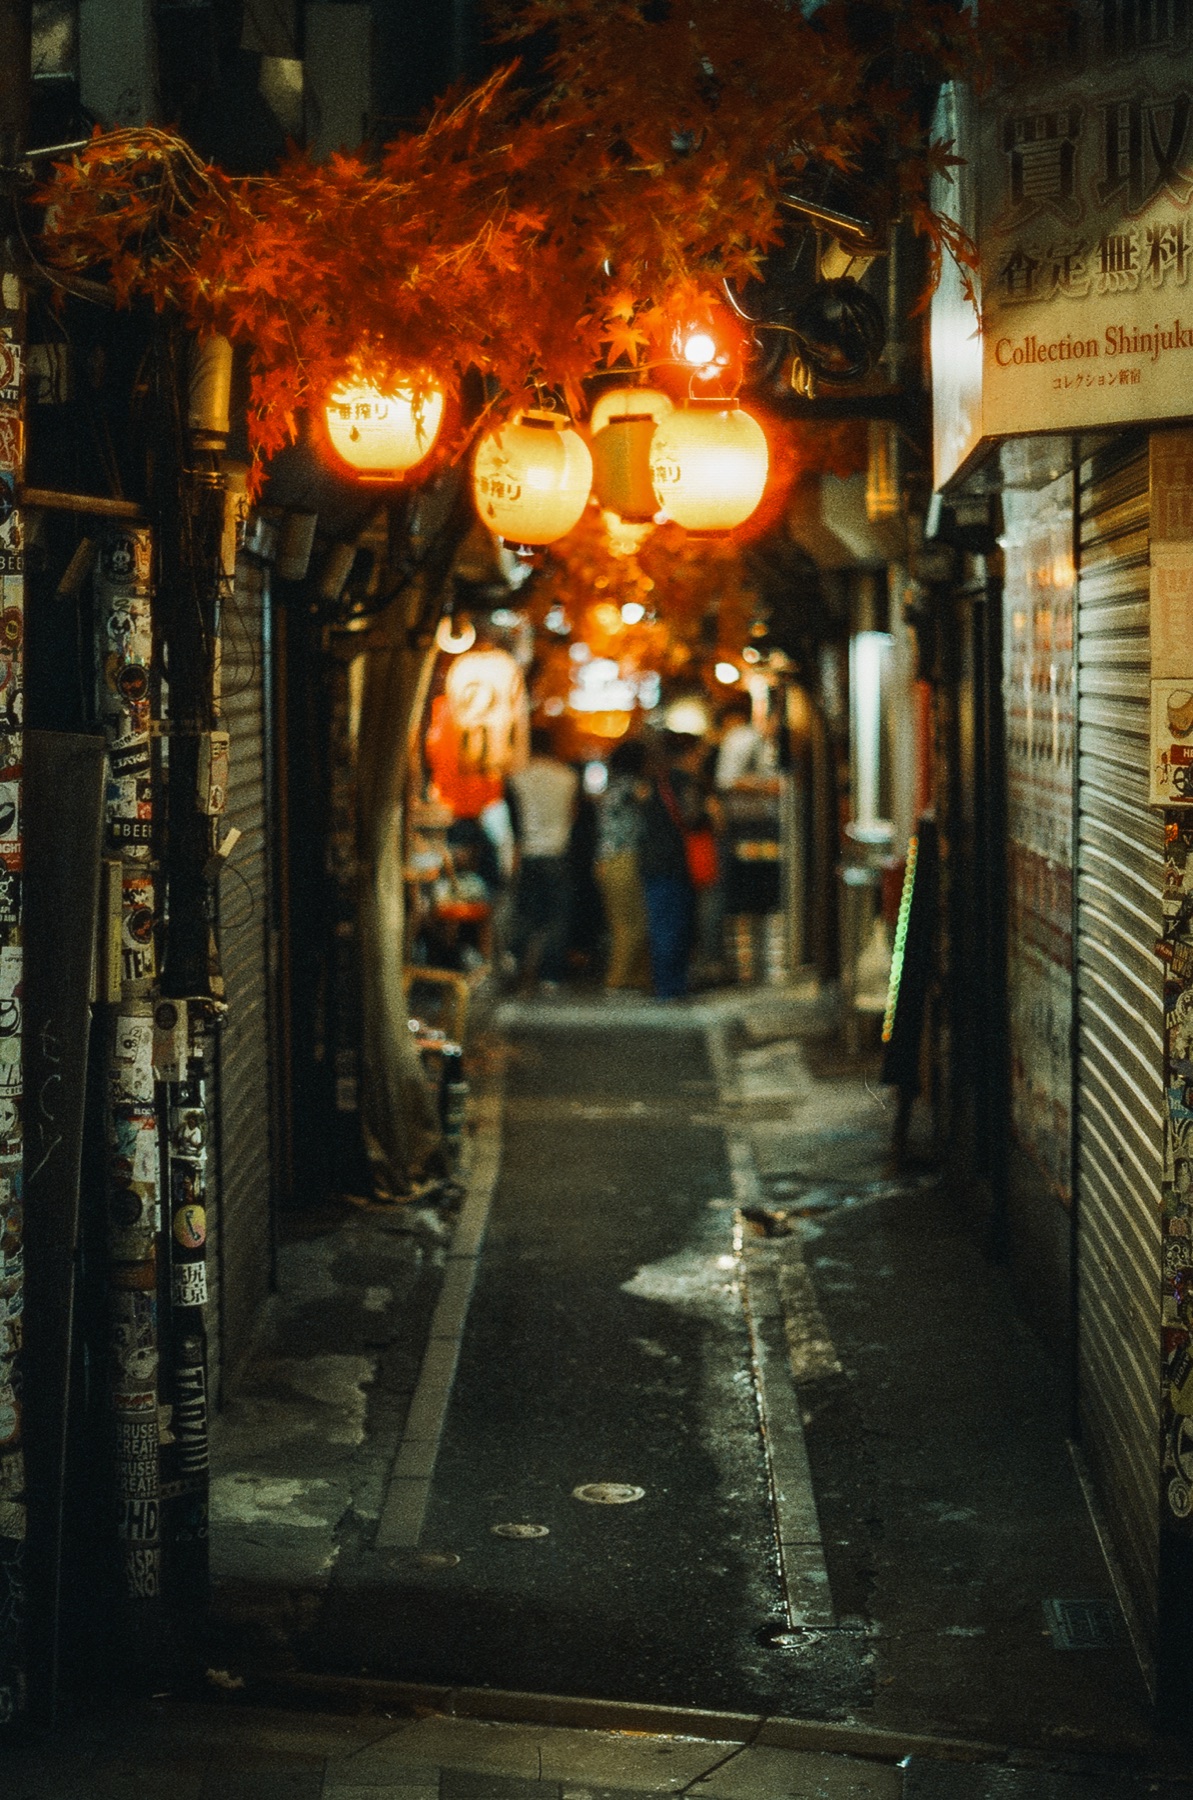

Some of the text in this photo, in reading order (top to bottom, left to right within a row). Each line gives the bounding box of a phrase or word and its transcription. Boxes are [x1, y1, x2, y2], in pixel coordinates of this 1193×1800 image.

[998, 222, 1193, 306] 査定無料
[995, 333, 1099, 368] Collection
[1053, 368, 1141, 391] コレクション新宿
